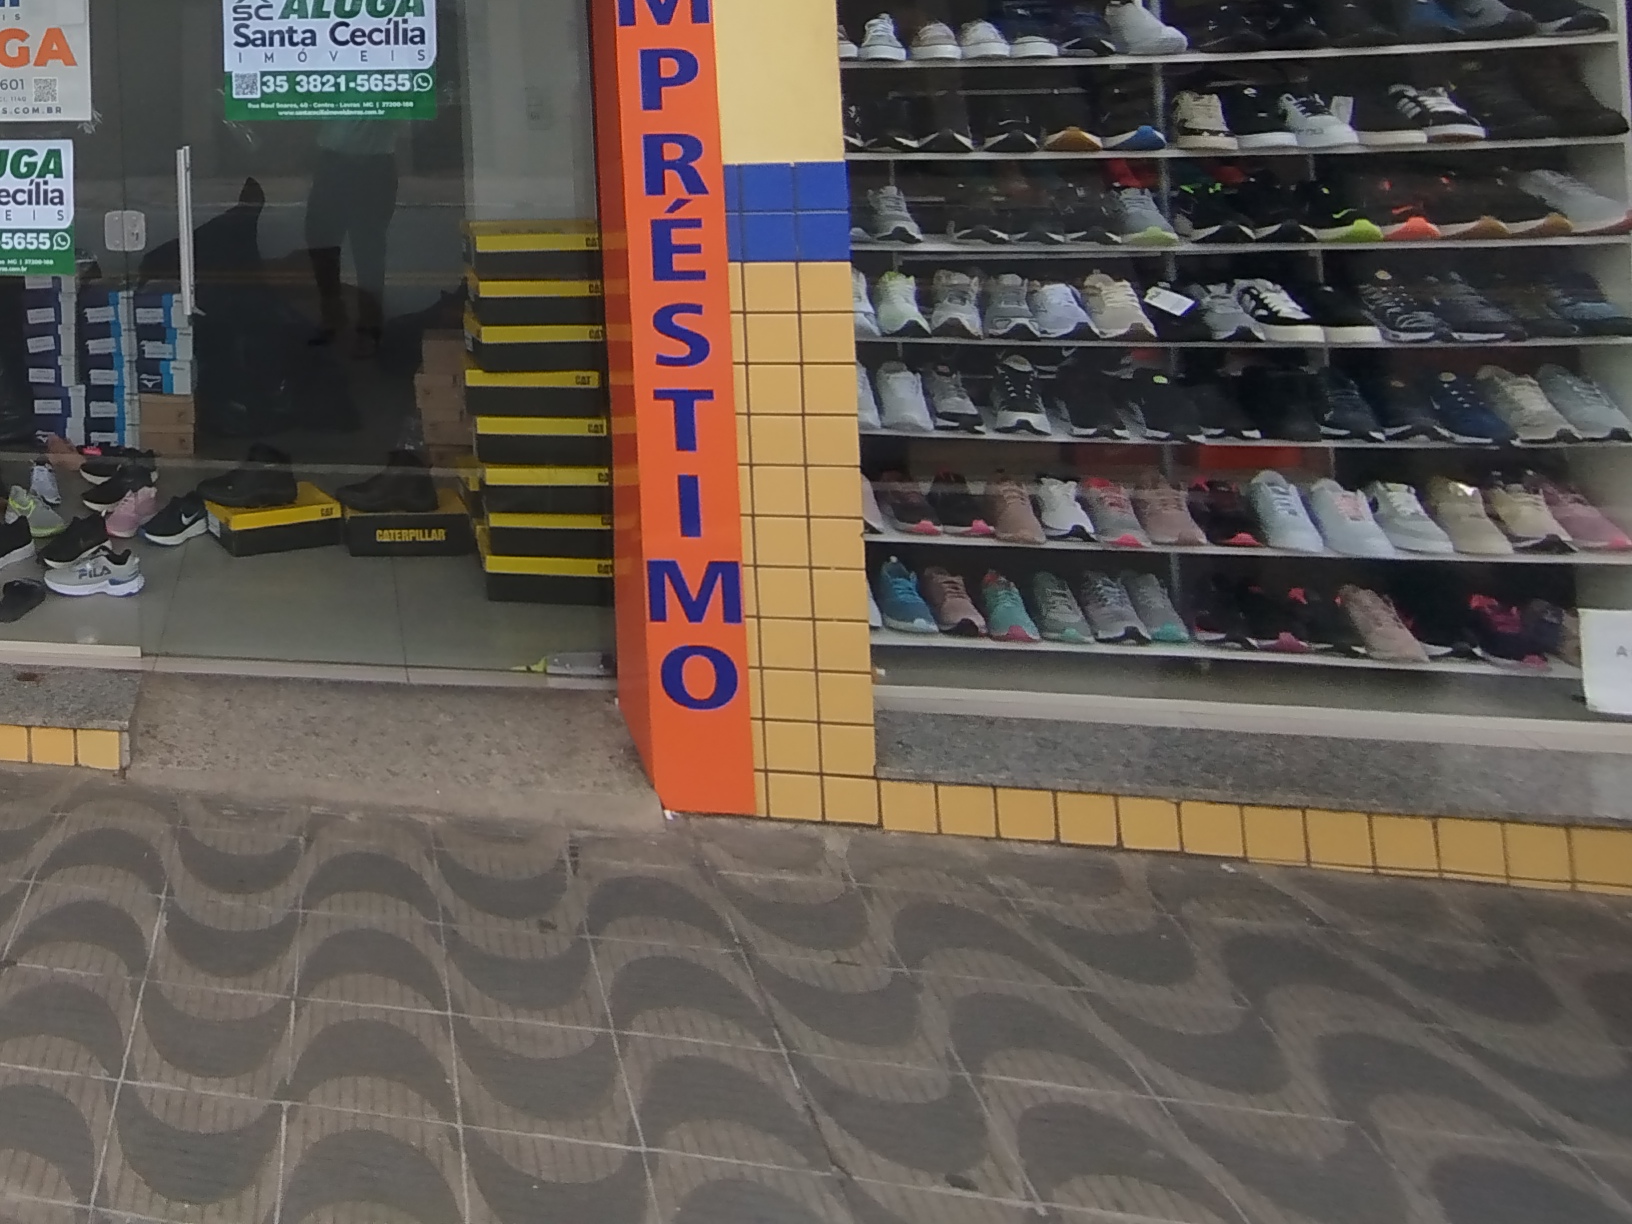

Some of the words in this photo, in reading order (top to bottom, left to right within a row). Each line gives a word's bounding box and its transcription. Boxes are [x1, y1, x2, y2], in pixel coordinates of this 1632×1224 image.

[233, 23, 317, 48] Santa
[329, 18, 426, 46] Cecília
[238, 48, 426, 64] IMÓVEIS
[261, 75, 289, 93] 35
[295, 74, 411, 92] 3821-5655
[375, 529, 446, 543] CATERPILLAR
[78, 565, 112, 579] FILA
